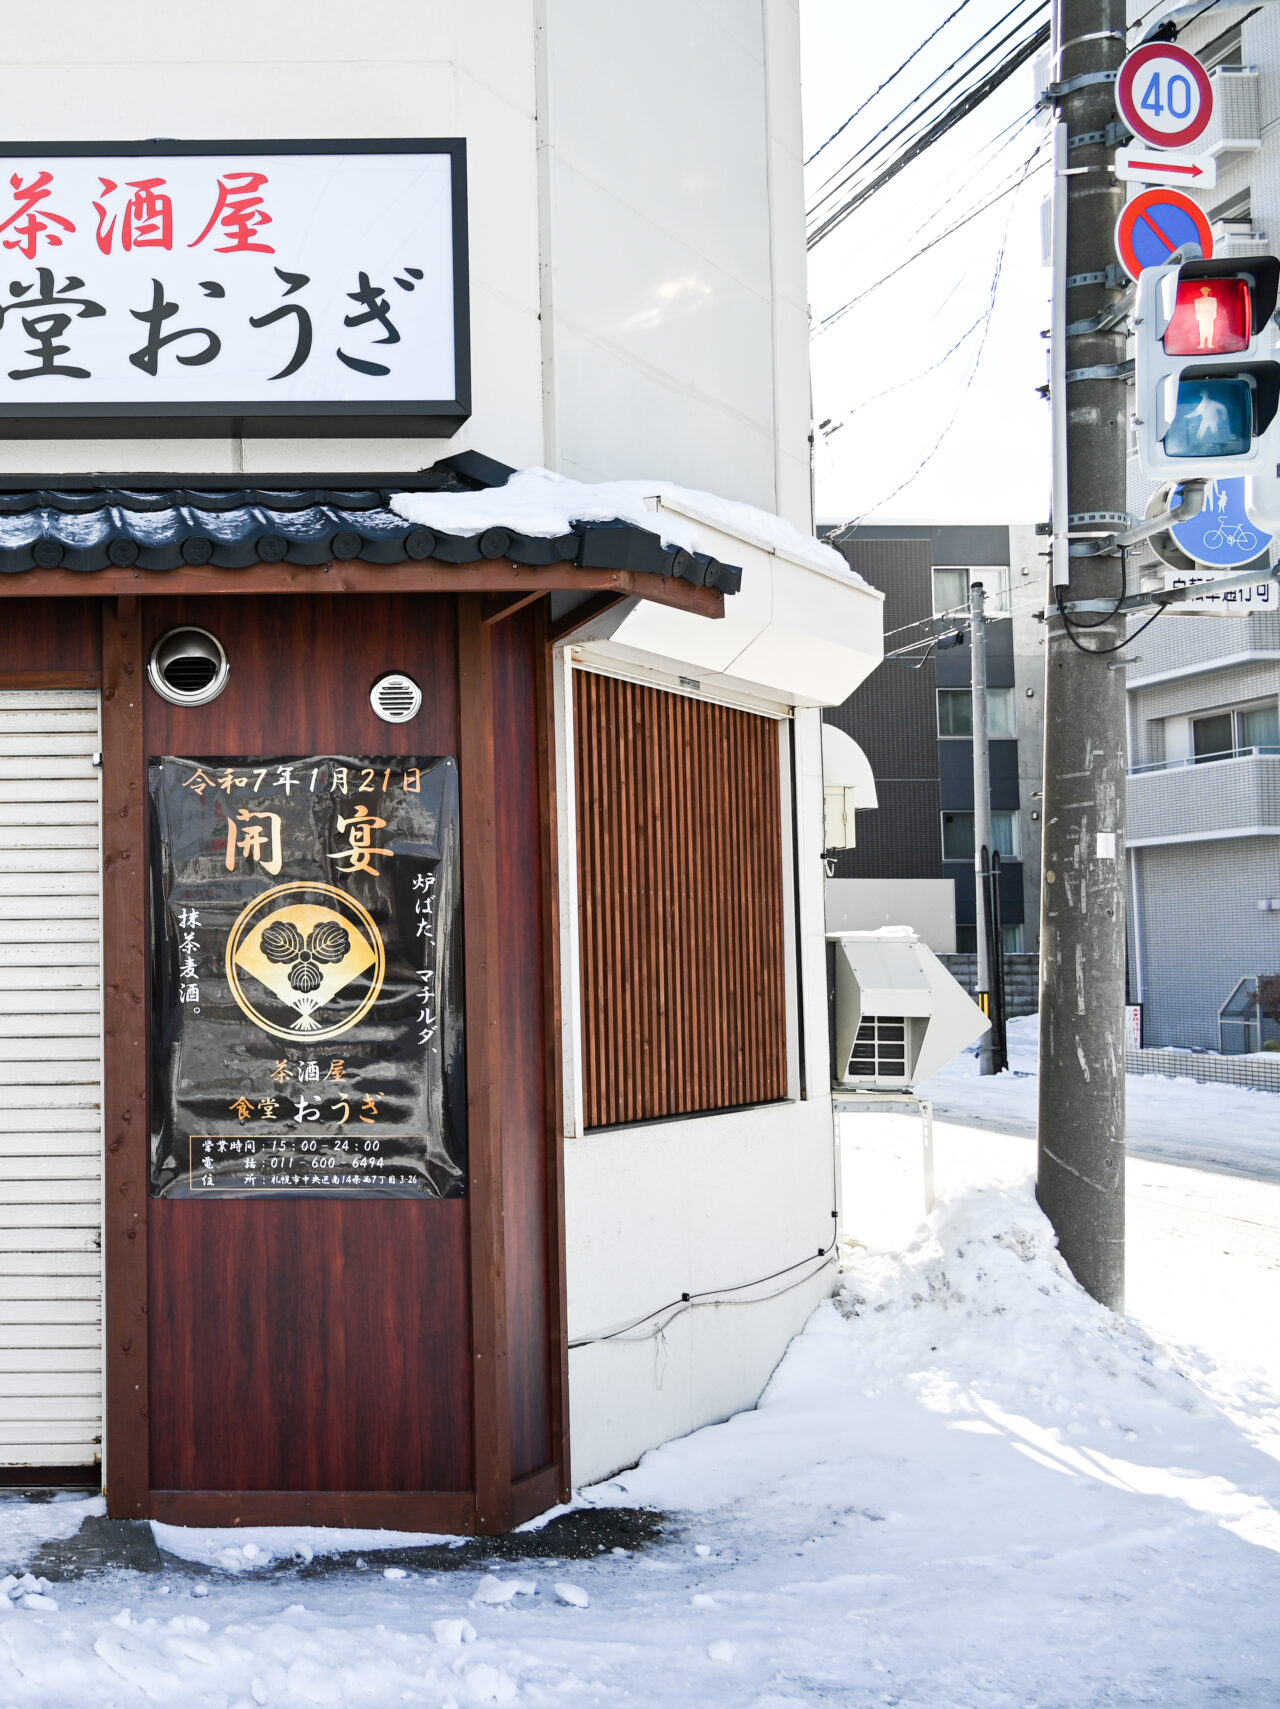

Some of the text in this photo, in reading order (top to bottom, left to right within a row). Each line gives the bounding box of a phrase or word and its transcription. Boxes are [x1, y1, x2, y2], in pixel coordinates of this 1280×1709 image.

[1140, 71, 1192, 119] 40
[182, 765, 421, 796] 令和7年1月21日
[271, 1059, 347, 1083] 茶酒屋
